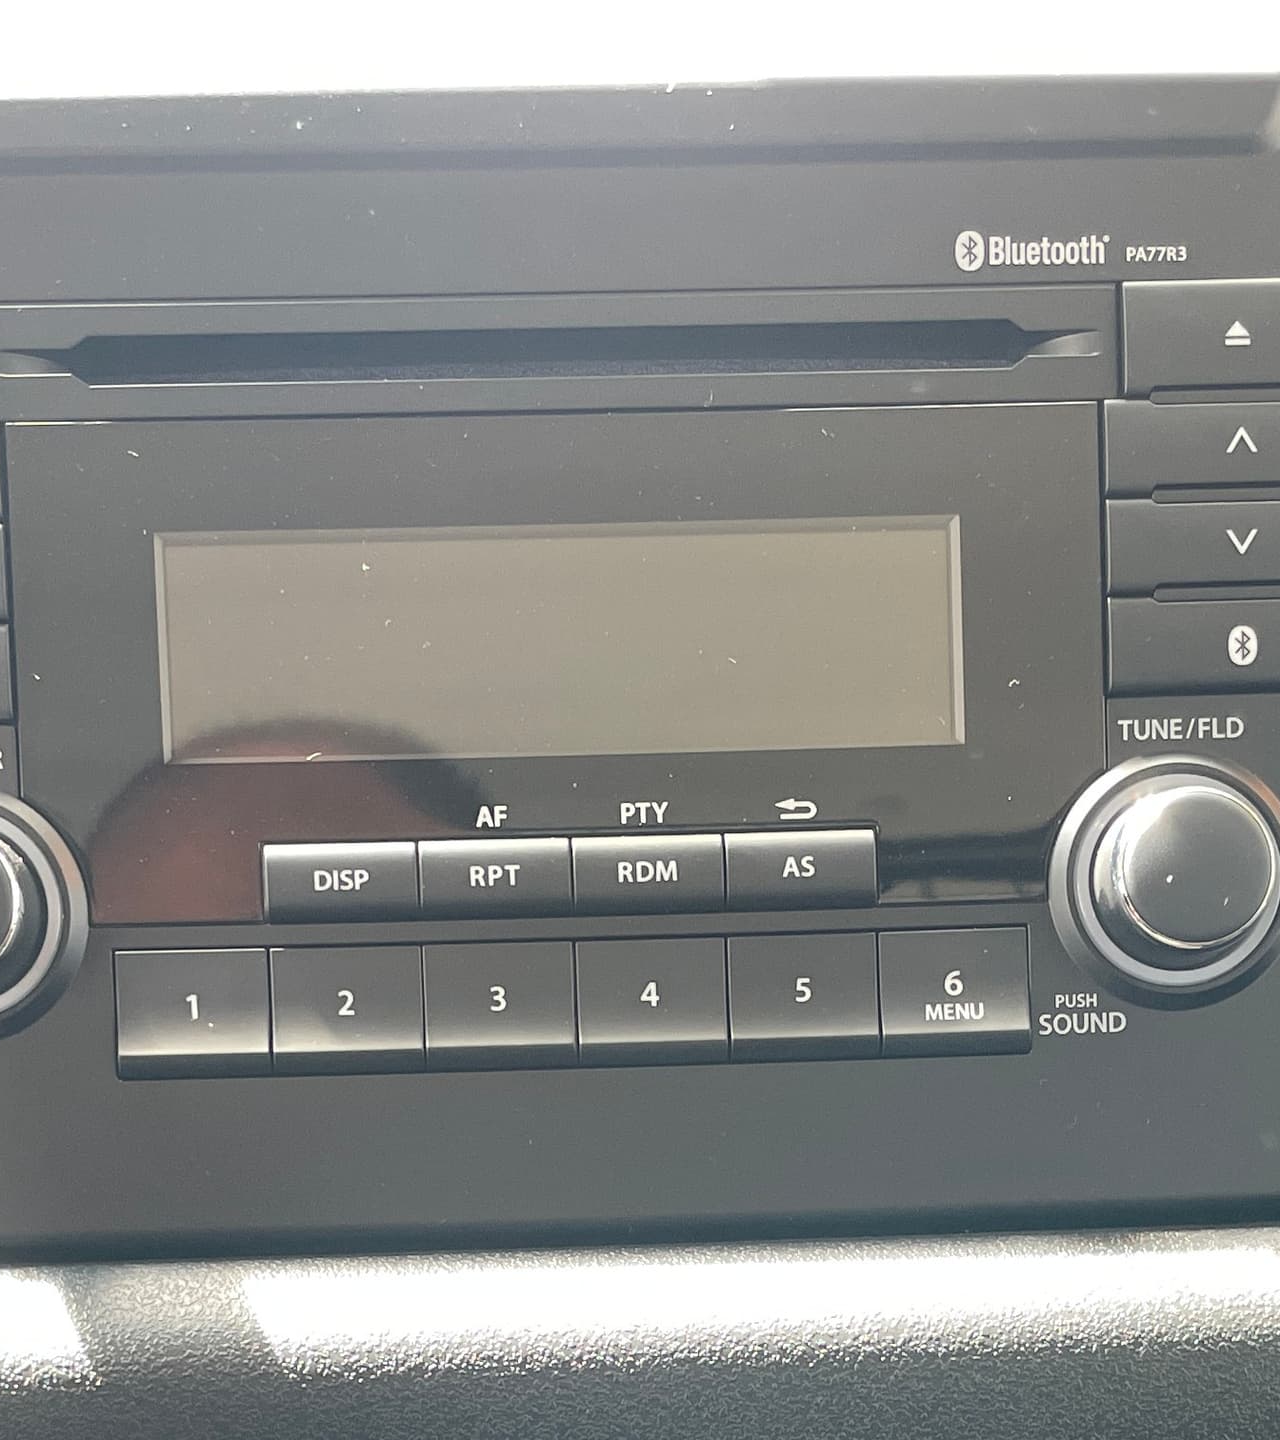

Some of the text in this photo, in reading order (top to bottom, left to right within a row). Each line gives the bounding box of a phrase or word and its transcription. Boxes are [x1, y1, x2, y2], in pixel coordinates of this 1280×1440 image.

[1125, 245, 1188, 263] PA77R3
[1117, 716, 1245, 741] TUNE/FLD
[475, 805, 508, 829] AF
[620, 801, 669, 825] PTY
[469, 864, 521, 888] RPT
[618, 861, 678, 883] RDM
[782, 856, 816, 878] AS
[313, 869, 370, 892] DISP
[639, 982, 660, 1007] 4
[795, 977, 812, 1003] 5
[943, 970, 964, 996] 6
[185, 994, 199, 1021] 1
[337, 990, 356, 1017] 2
[489, 986, 508, 1012] 3
[1054, 993, 1098, 1008] PUSH
[924, 1002, 985, 1021] MENU
[1038, 1012, 1127, 1035] SOUND
